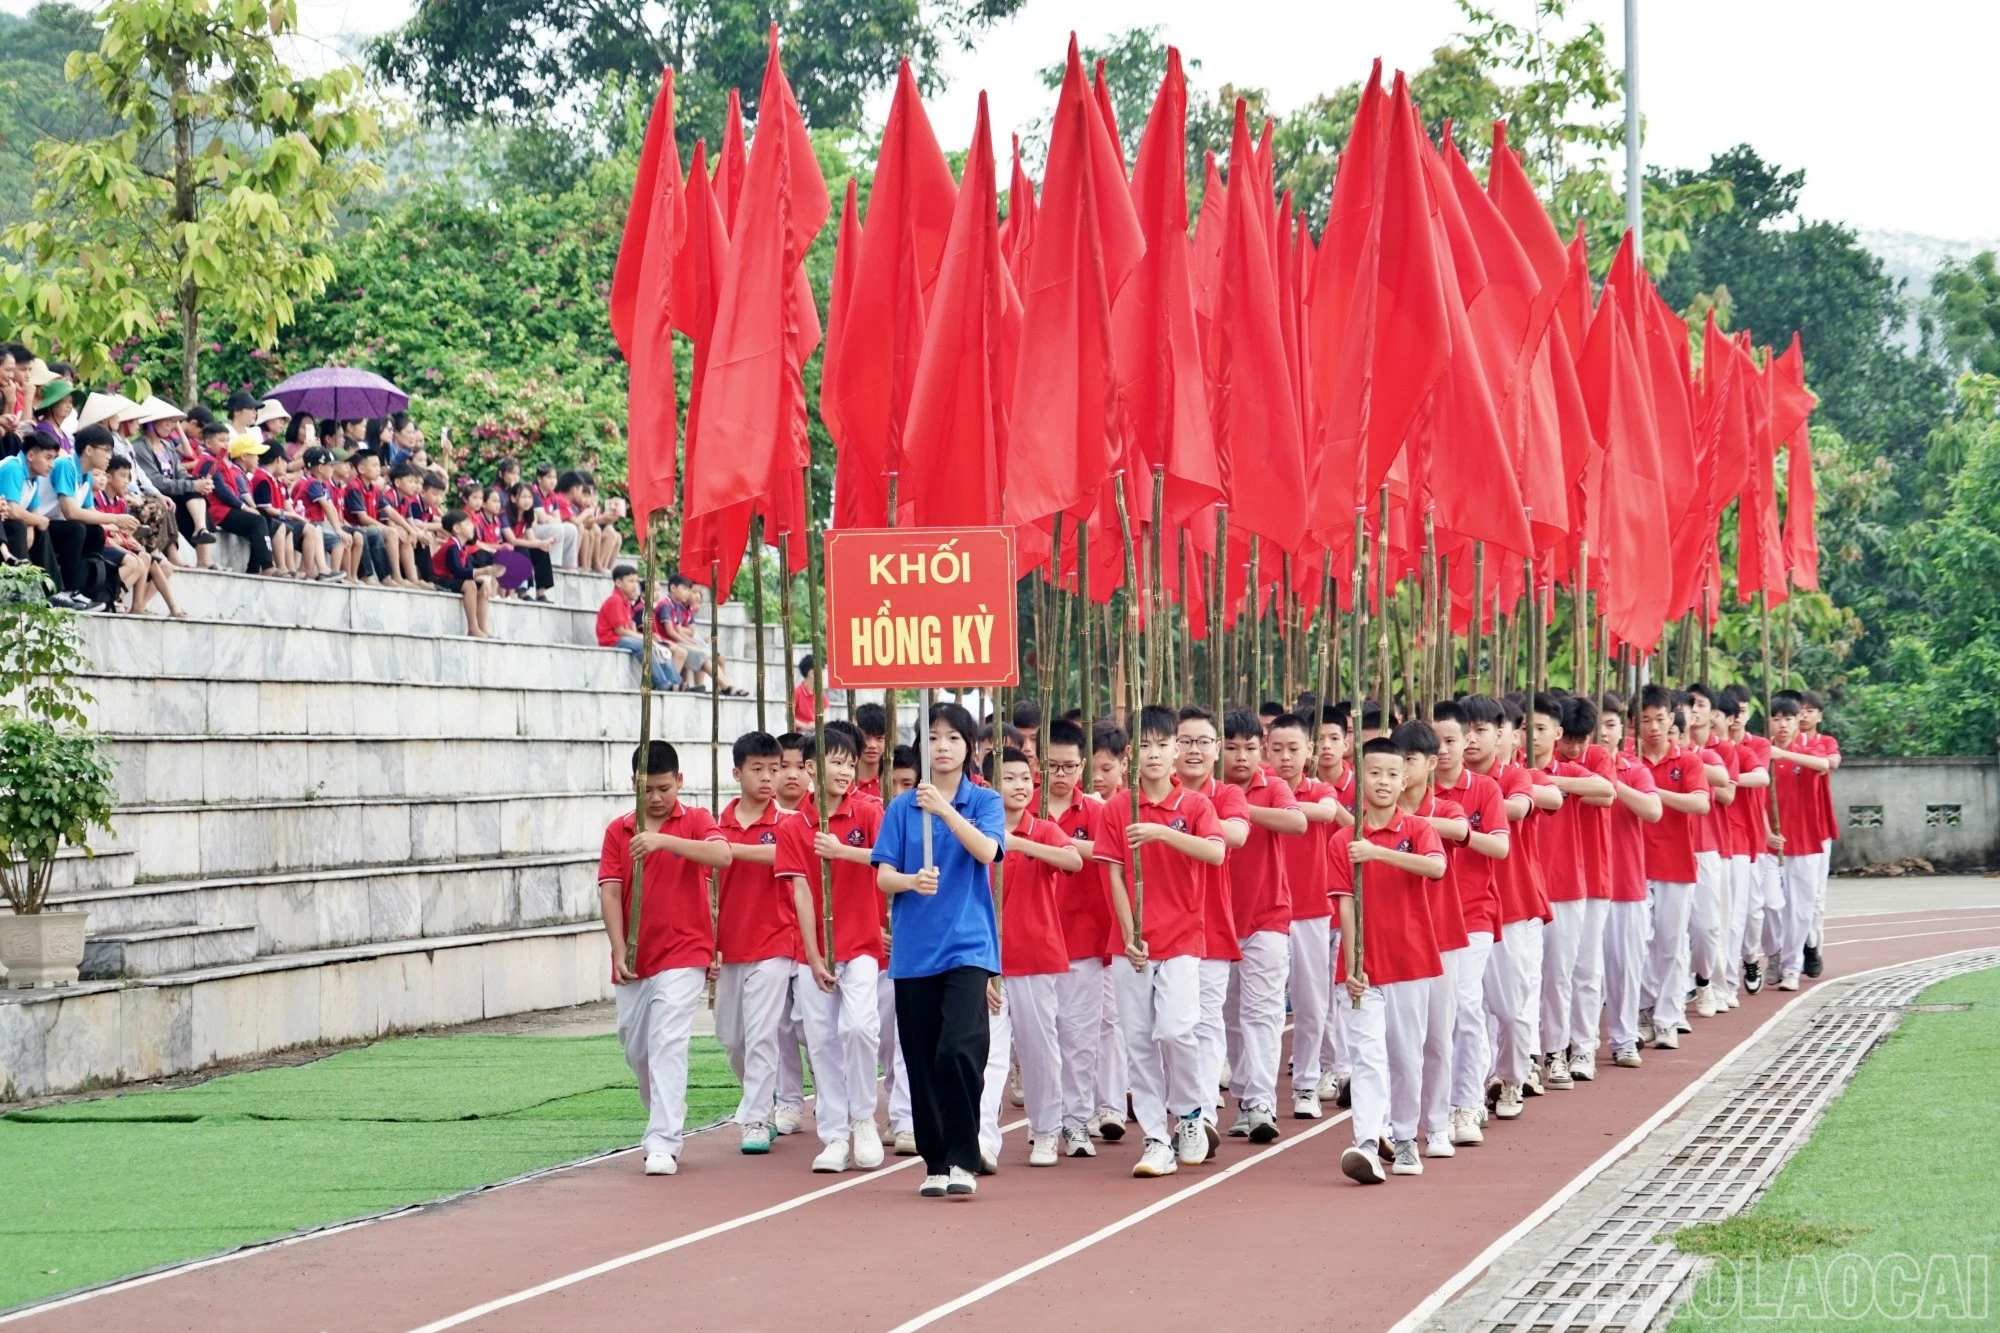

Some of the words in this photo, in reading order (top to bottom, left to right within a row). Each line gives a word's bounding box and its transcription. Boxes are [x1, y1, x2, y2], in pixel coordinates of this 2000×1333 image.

[870, 538, 971, 585] KHỐI
[851, 600, 942, 666] HỒNG
[953, 603, 994, 664] KỲ
